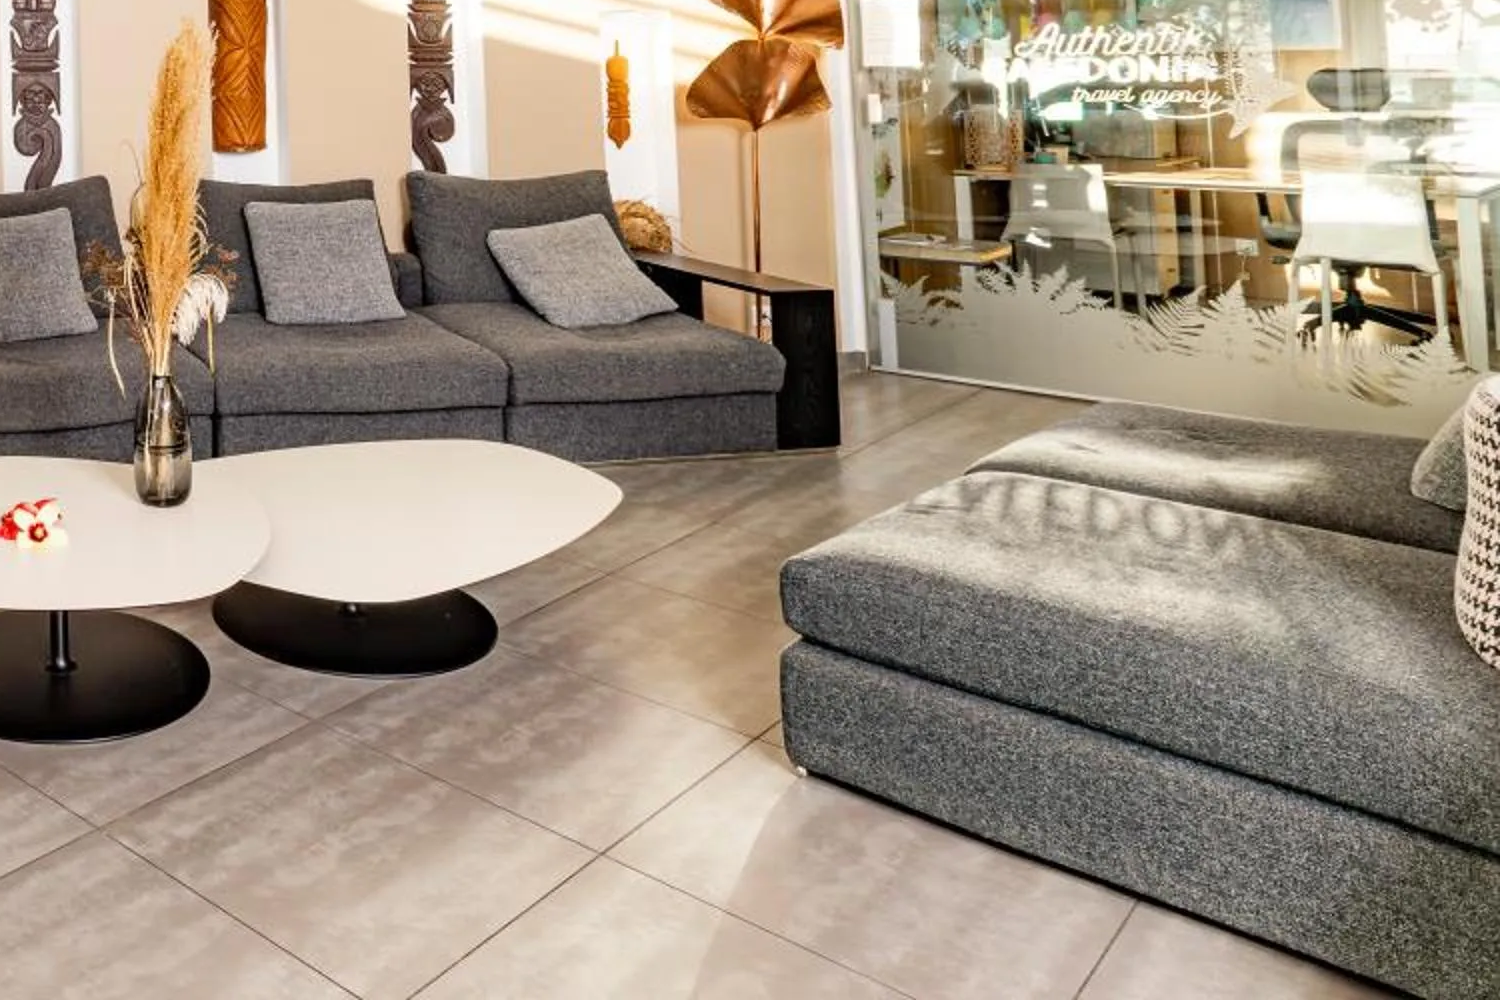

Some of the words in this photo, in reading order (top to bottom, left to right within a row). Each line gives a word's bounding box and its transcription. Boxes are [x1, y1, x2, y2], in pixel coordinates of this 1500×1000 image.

[1014, 22, 1206, 57] Authentik
[1071, 85, 1135, 103] travel
[1139, 86, 1223, 109] agency
